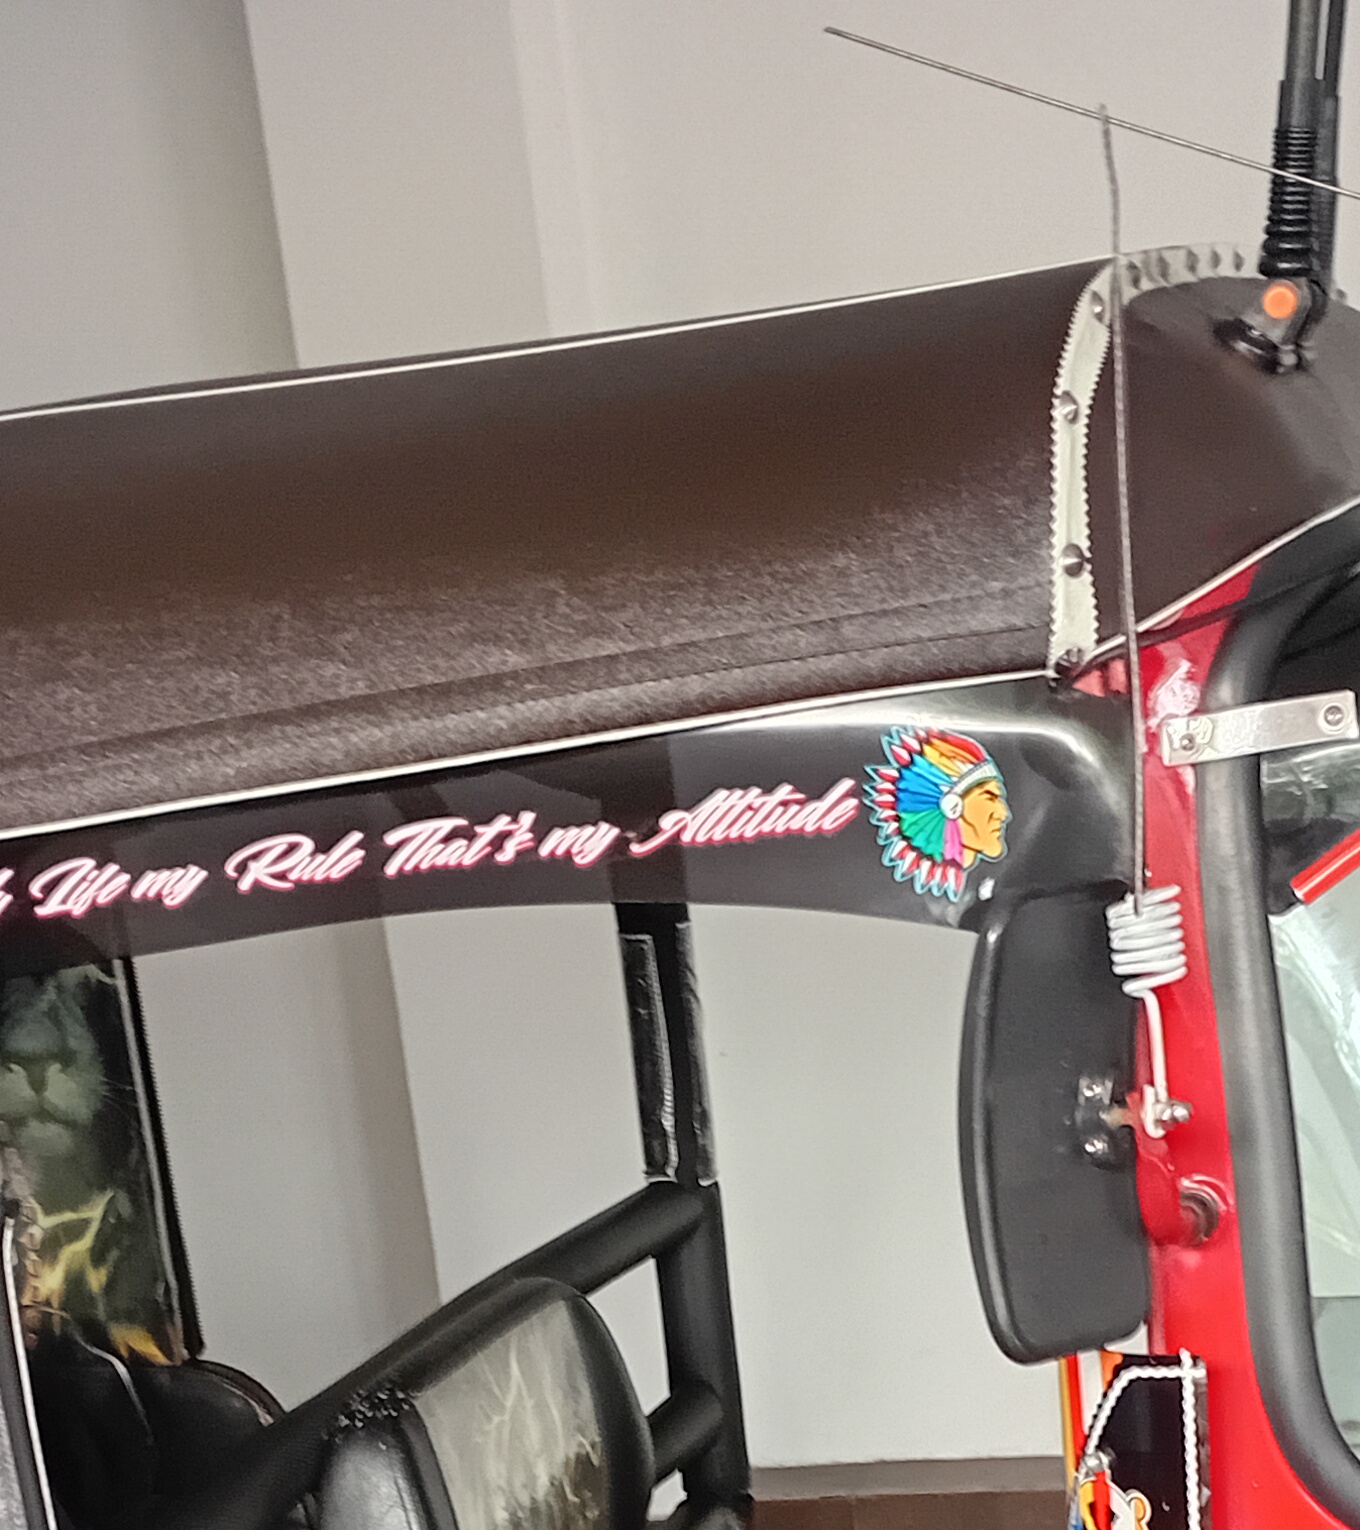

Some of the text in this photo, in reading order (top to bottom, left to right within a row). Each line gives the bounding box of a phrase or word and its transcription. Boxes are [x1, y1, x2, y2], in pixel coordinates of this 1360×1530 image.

[28, 857, 131, 917] Life
[130, 863, 208, 908] my
[225, 830, 366, 893] Rule
[383, 809, 537, 878] That's
[538, 820, 621, 868] my
